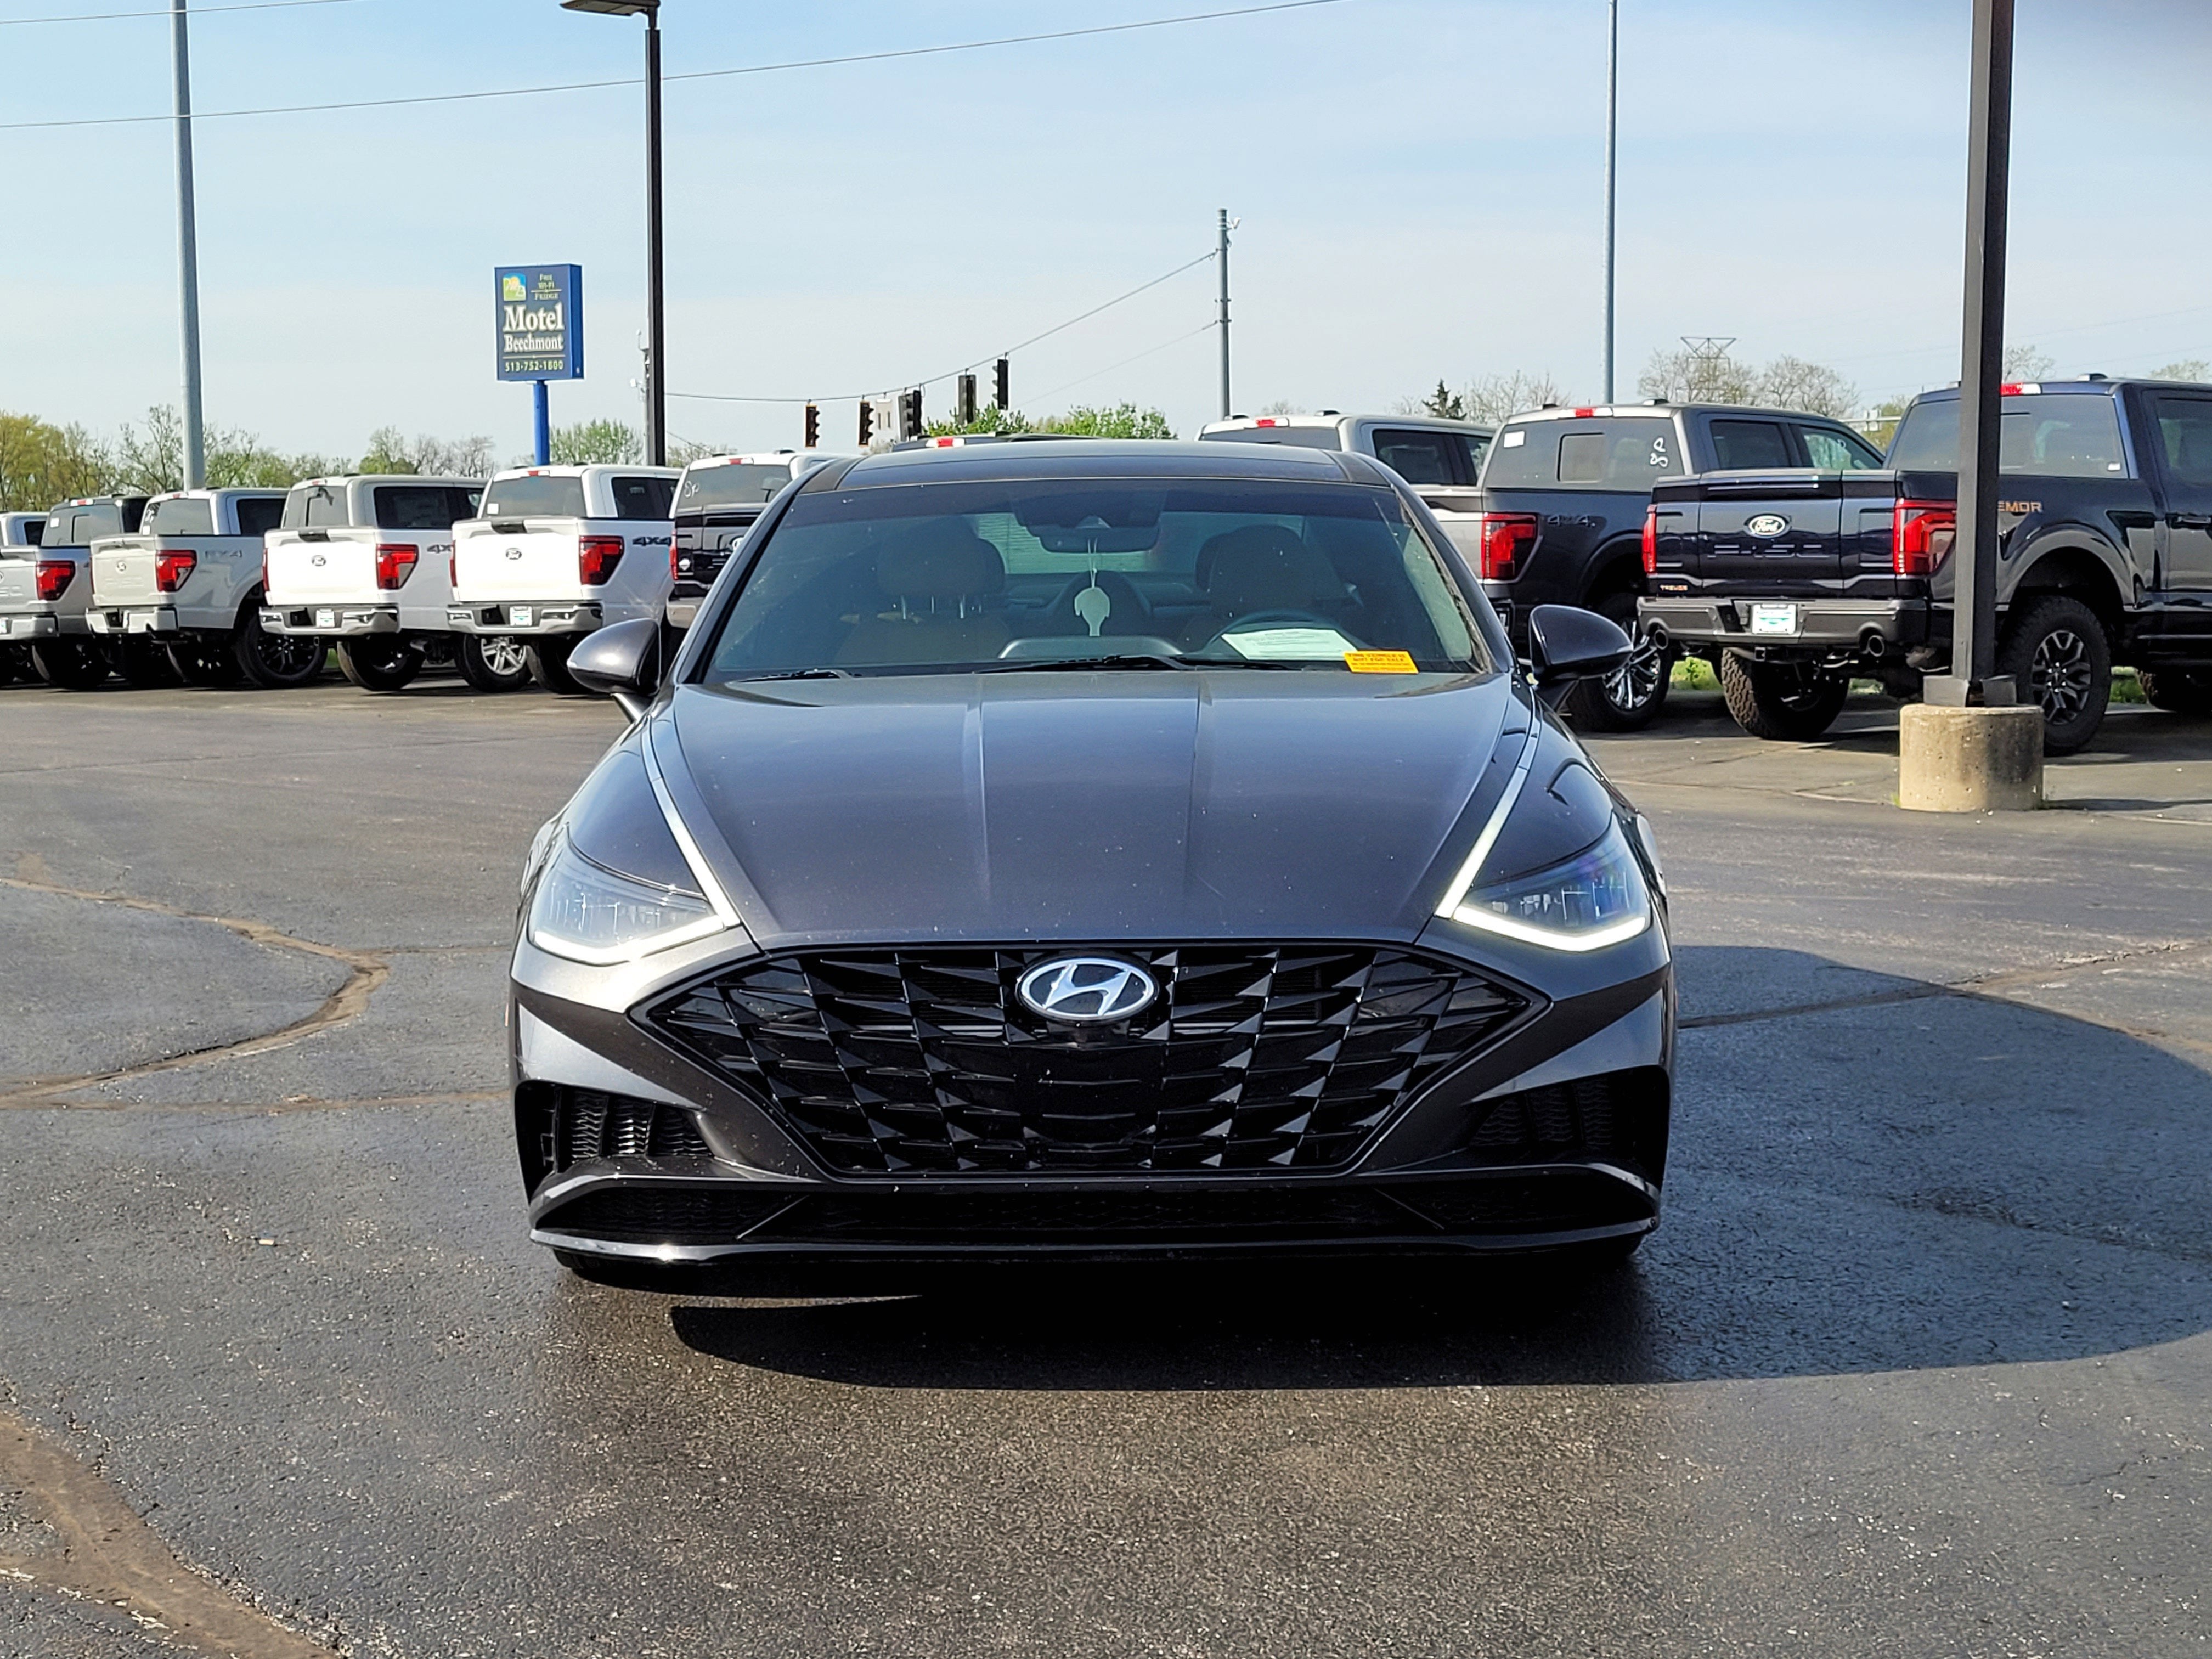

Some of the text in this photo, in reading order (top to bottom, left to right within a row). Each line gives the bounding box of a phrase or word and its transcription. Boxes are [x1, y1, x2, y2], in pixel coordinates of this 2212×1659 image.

[503, 302, 565, 332] Motel
[503, 332, 565, 352] Beechmont
[1997, 500, 2043, 514] EMOR
